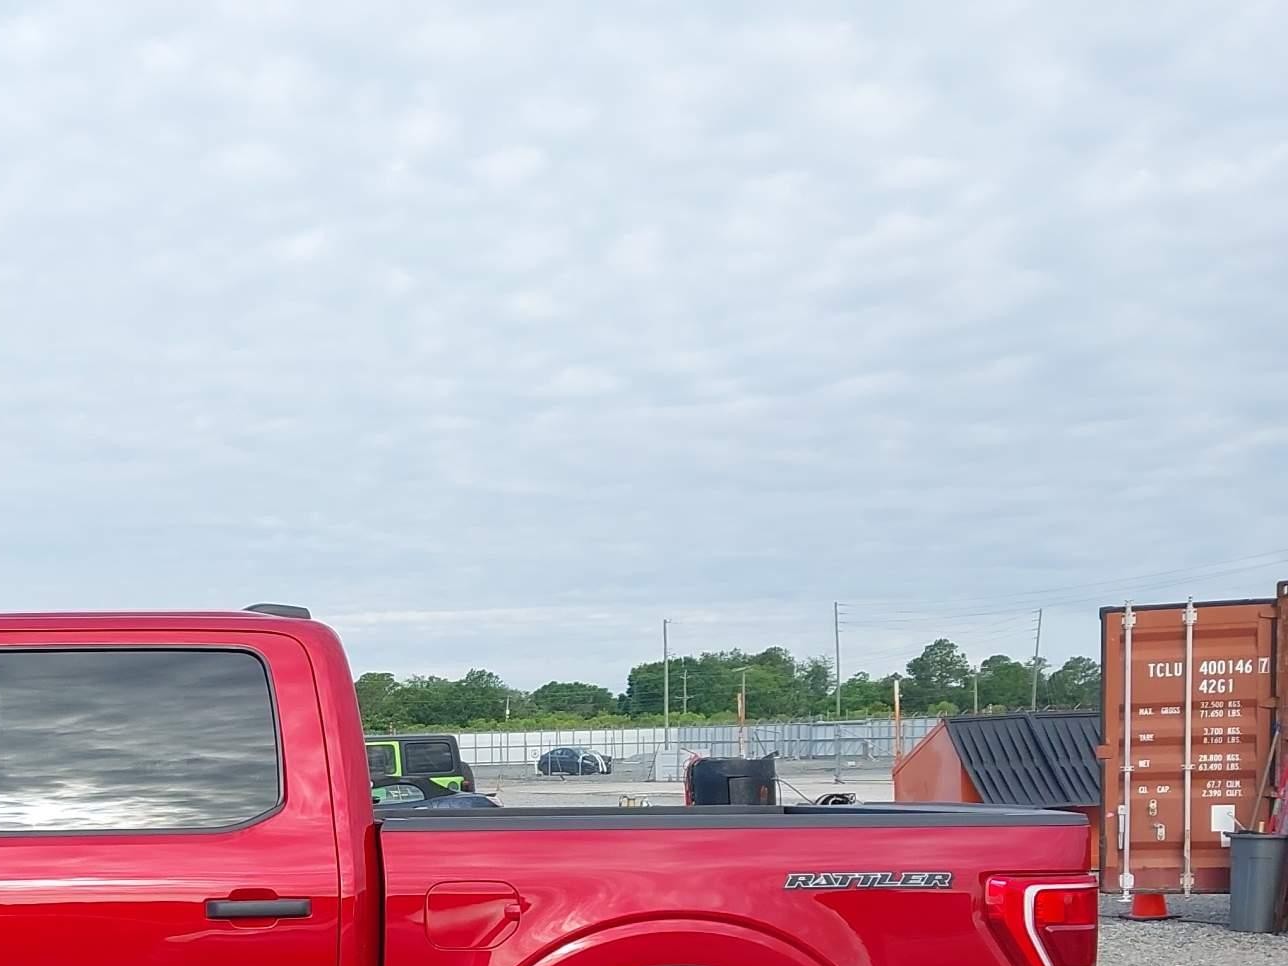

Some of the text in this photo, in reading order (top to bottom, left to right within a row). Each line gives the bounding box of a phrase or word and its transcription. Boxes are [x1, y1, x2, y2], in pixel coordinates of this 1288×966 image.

[1148, 657, 1269, 678] TCLU 400146 7
[1199, 679, 1234, 694] 42G1
[784, 871, 952, 889] RATTLER
